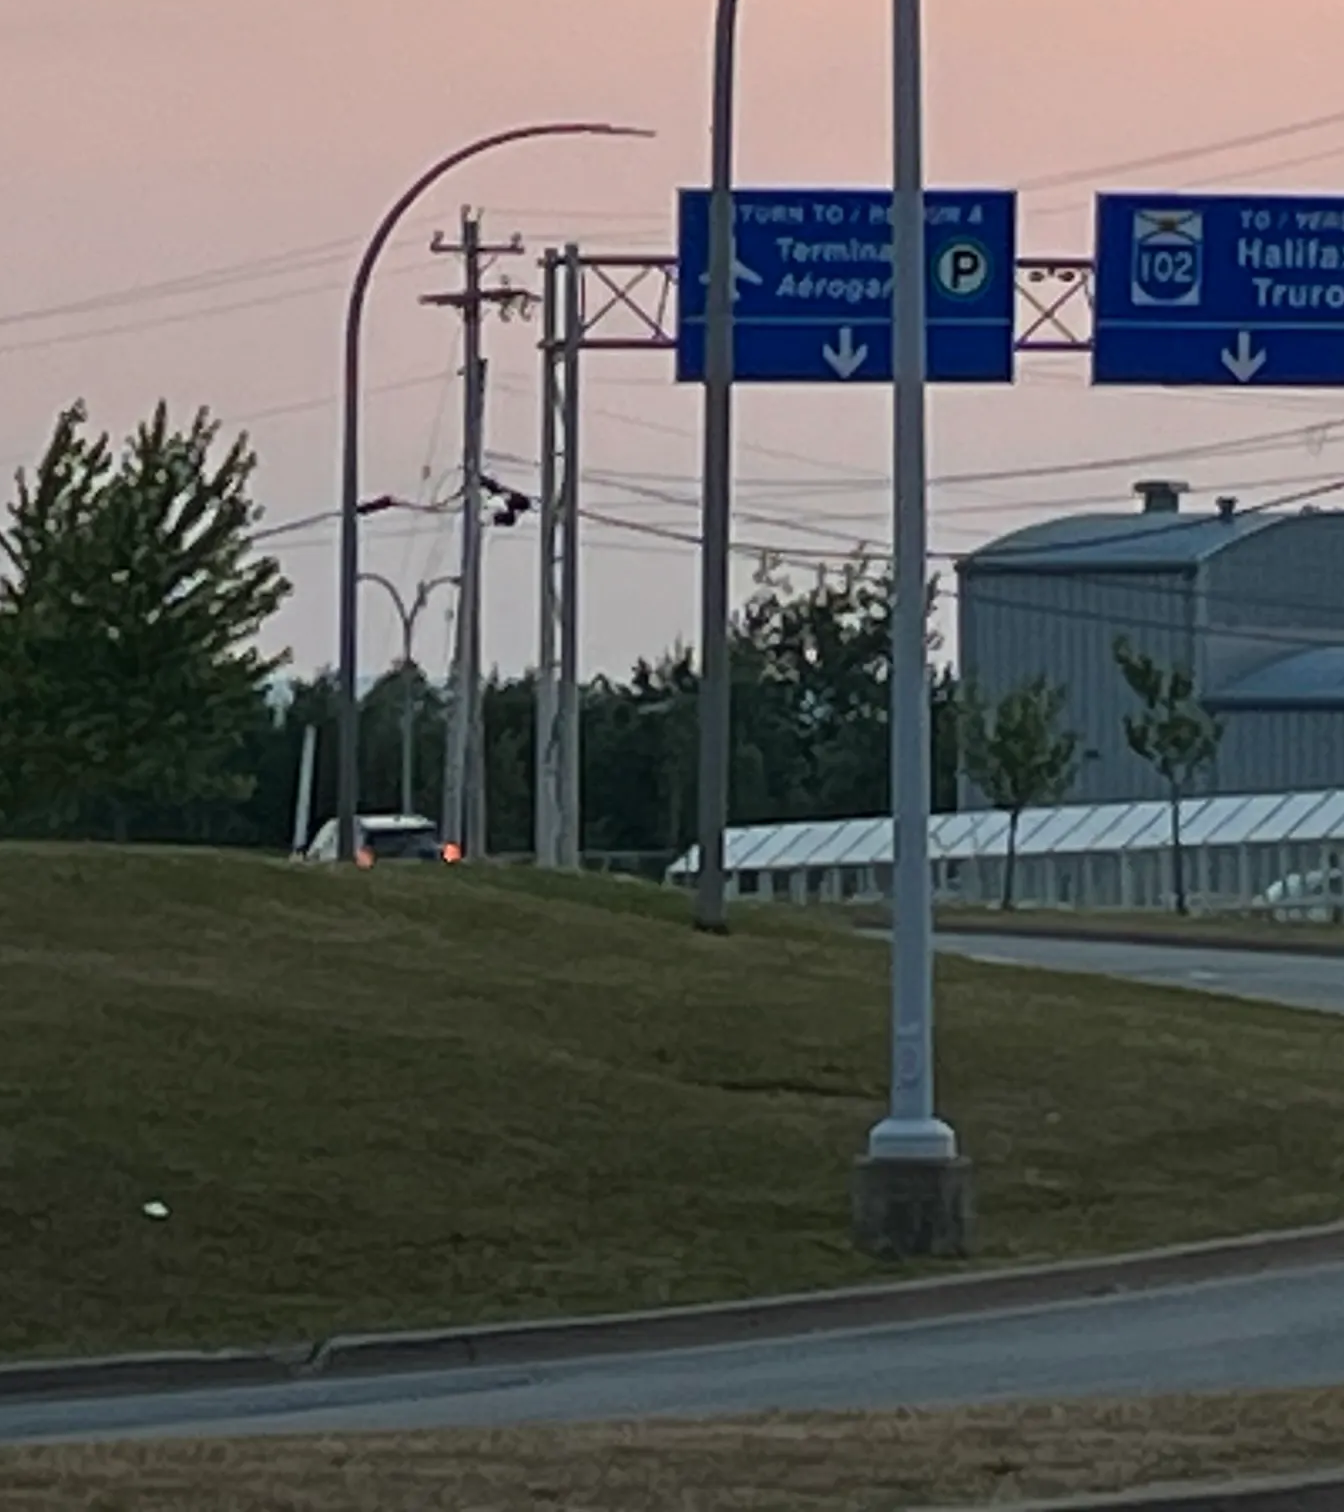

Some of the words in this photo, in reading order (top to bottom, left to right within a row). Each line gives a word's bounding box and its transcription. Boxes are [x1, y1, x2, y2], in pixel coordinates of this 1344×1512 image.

[739, 203, 805, 226] TURN
[813, 203, 845, 226] TO
[1240, 209, 1272, 232] TO
[773, 236, 895, 263] Termina
[952, 250, 979, 289] P
[1140, 250, 1194, 284] 102
[774, 271, 895, 305] Aérogar
